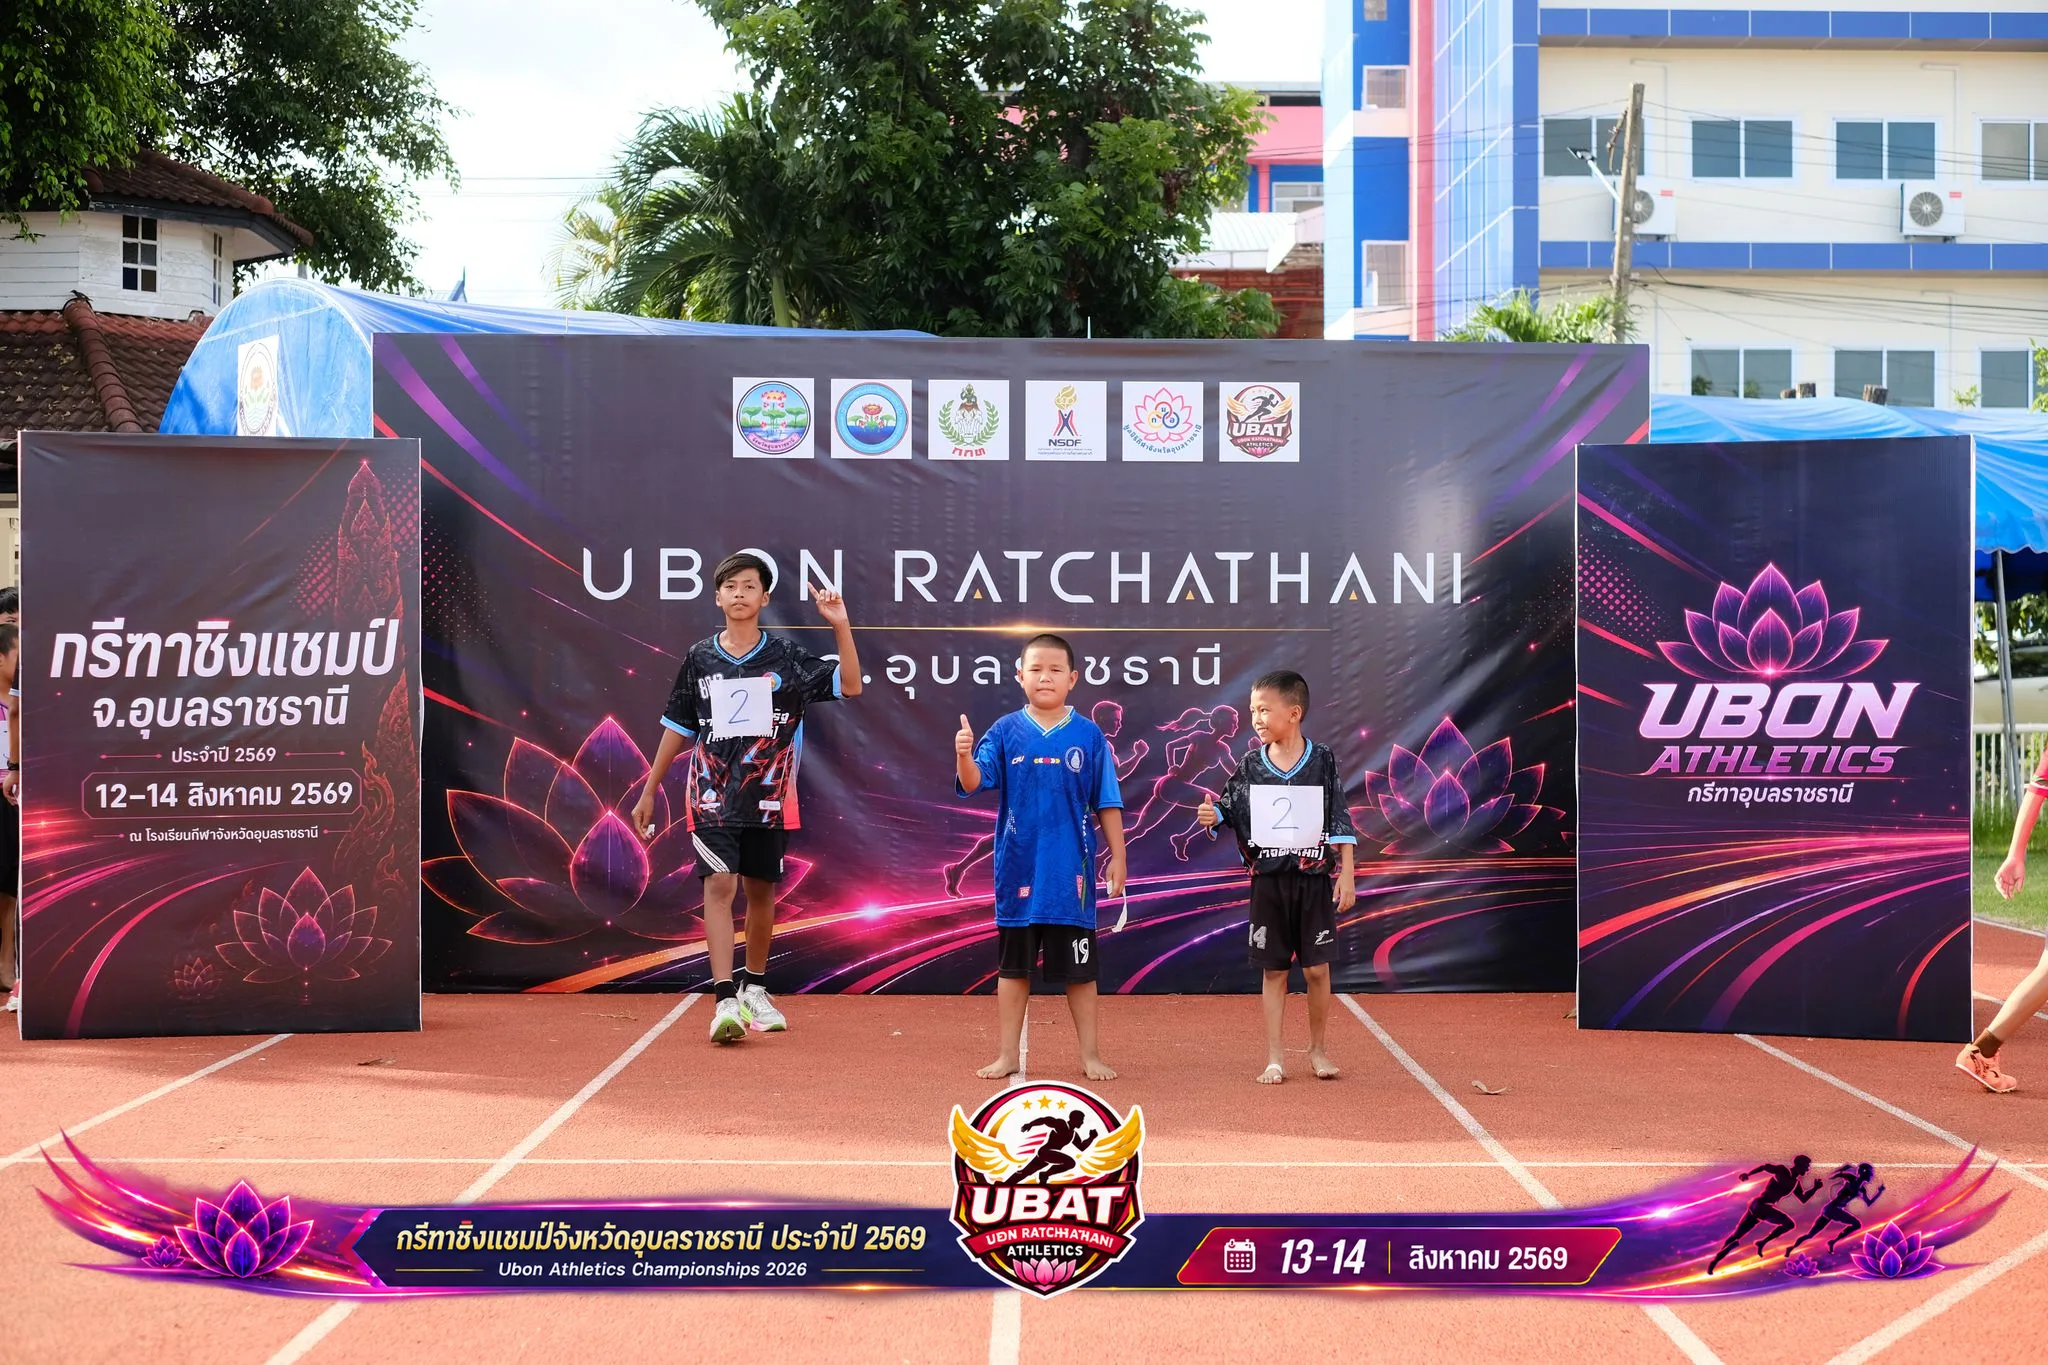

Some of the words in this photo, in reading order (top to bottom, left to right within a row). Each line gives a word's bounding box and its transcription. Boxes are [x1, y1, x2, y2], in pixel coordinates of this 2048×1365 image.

[1048, 439, 1082, 447] NSDF
[1232, 422, 1287, 437] UBAT
[894, 550, 1462, 604] RATCHATHANI
[50, 617, 400, 678] กรีฑาชิงแชมป์
[93, 684, 350, 740] จ.อุบลราชธานี
[728, 689, 750, 724] 2
[1638, 682, 1921, 739] UBON
[171, 746, 229, 763] ประจำปี
[235, 747, 277, 762] 2569
[1644, 745, 1905, 775] ATHLETICS
[188, 782, 281, 807] สิงหาคม
[291, 782, 353, 805] 2569
[1272, 797, 1299, 830] 2
[129, 830, 142, 842] ณ
[146, 826, 319, 843] โรงเรียนกีฬาจังหวัดอุบลราชธานี
[1072, 938, 1089, 964] 19
